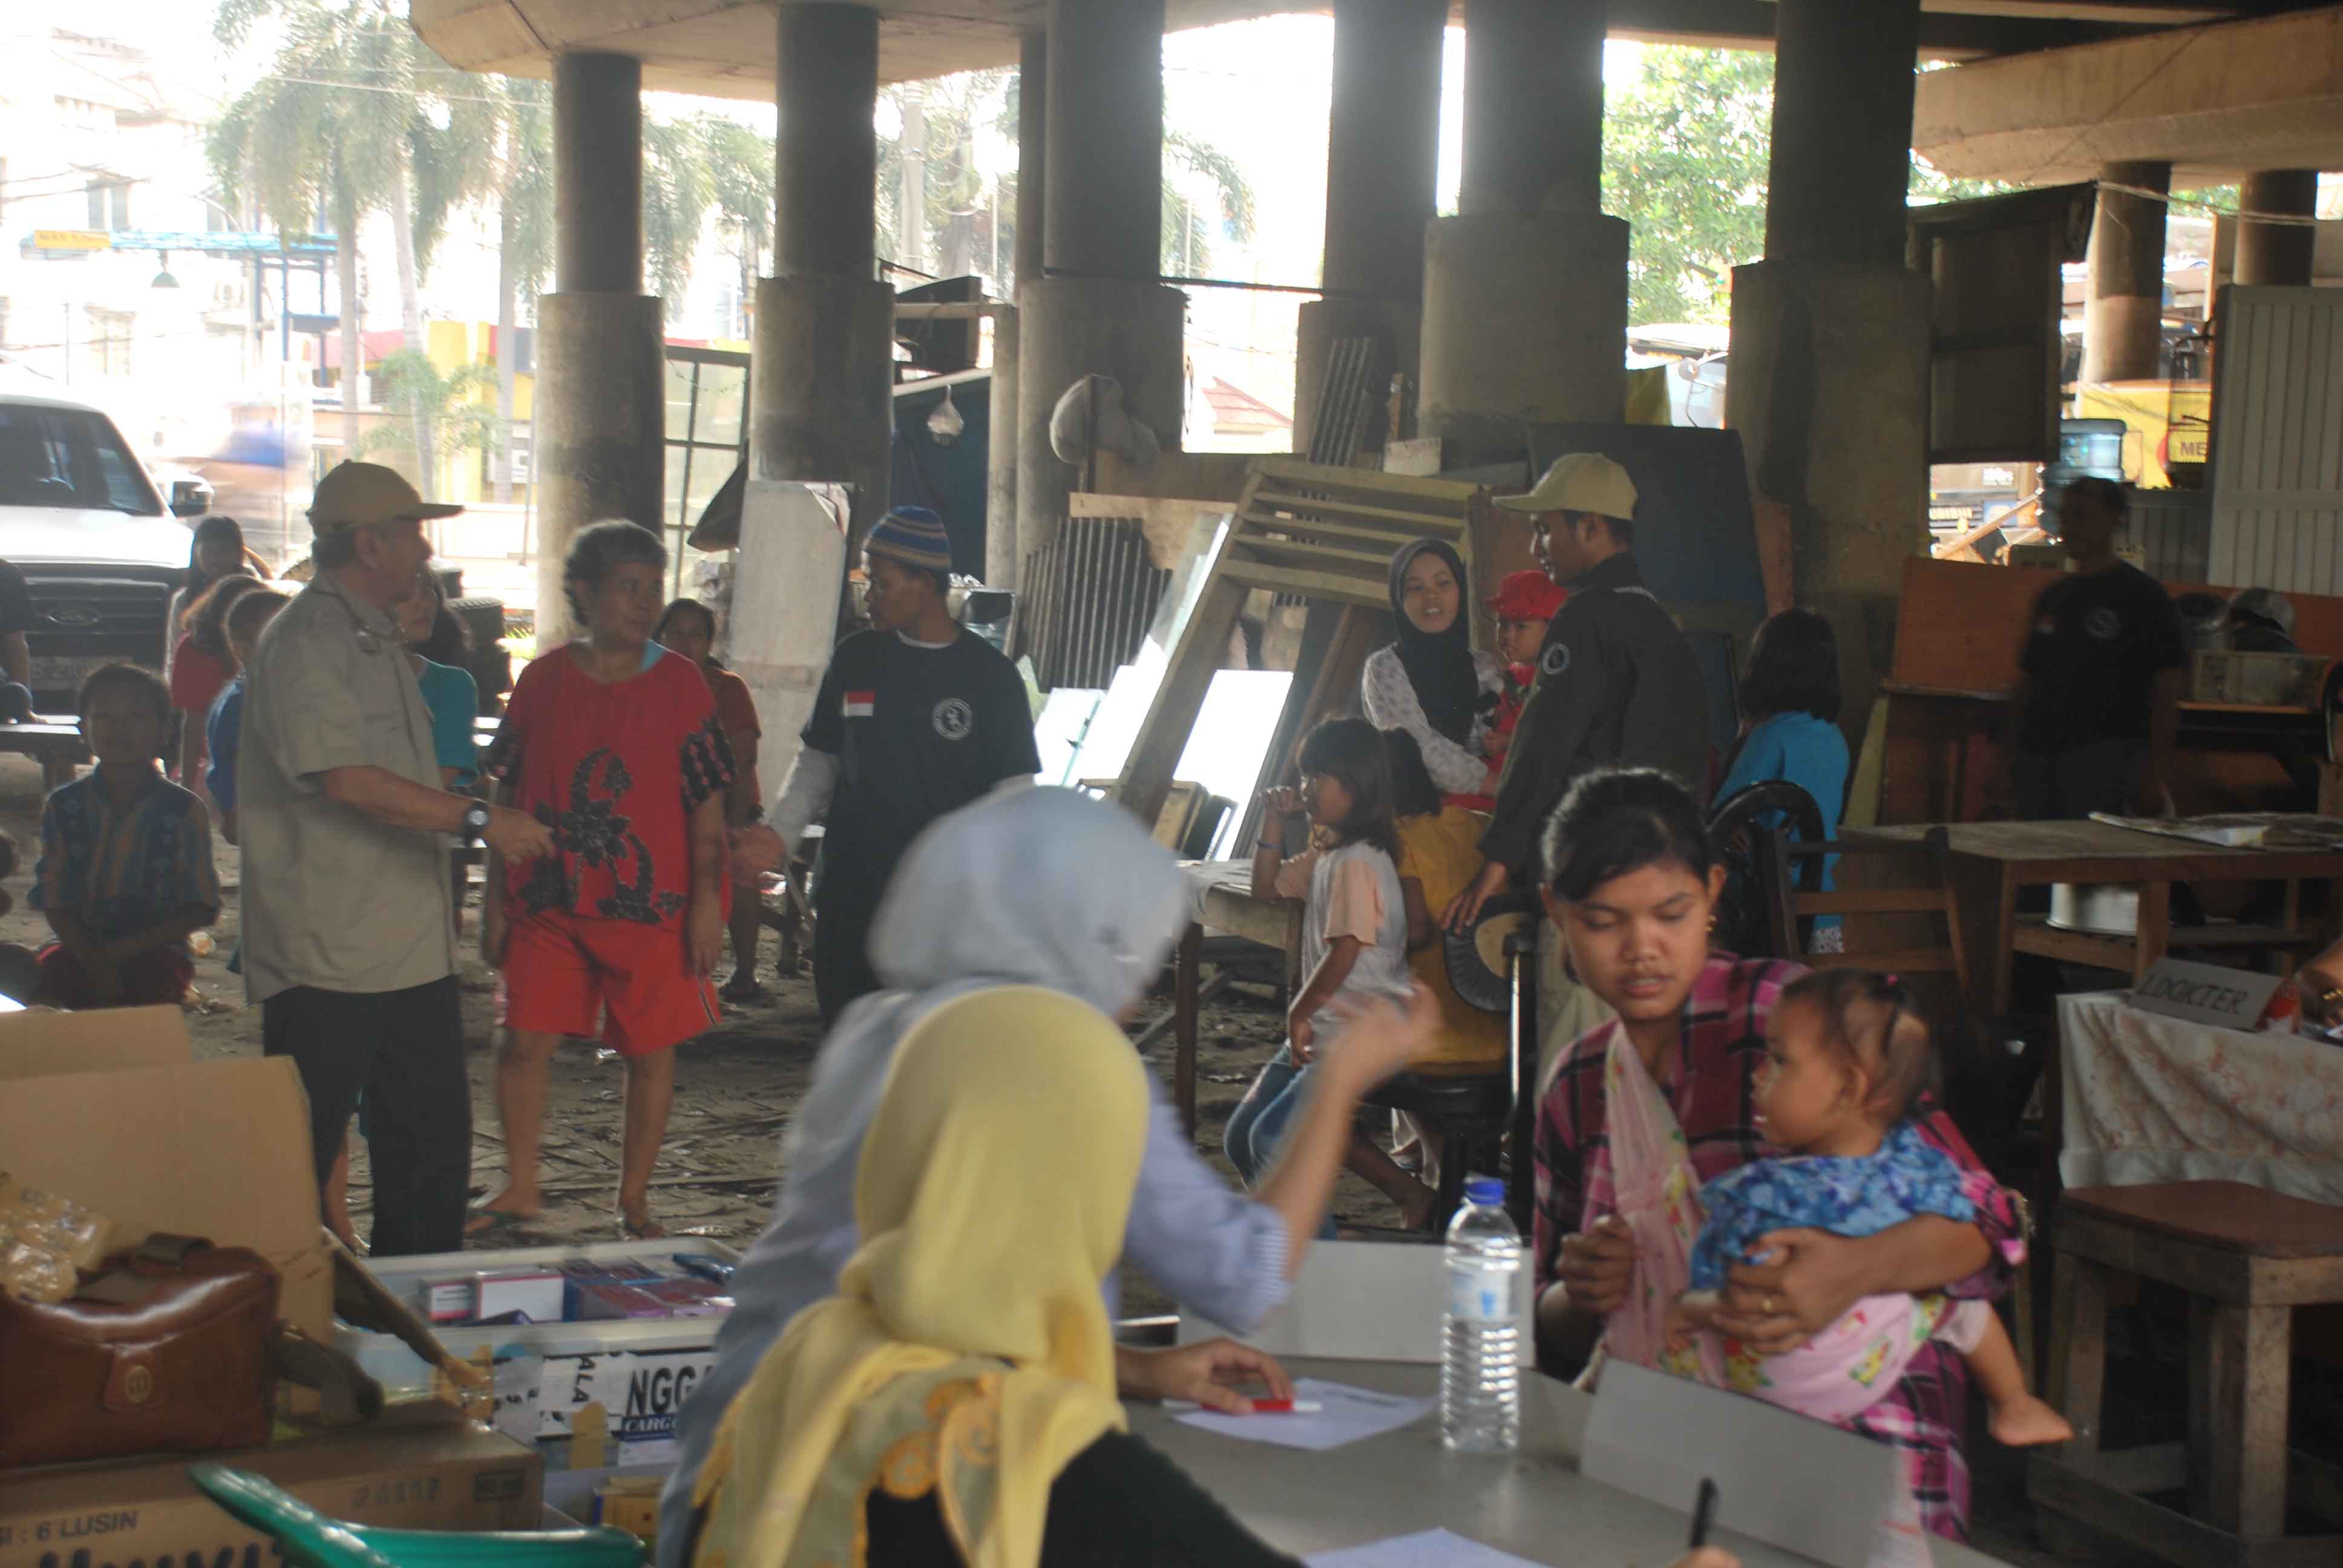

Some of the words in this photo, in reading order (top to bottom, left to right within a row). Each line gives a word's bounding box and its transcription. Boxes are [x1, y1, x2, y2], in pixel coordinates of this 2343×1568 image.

[626, 1365, 715, 1416] NGG
[624, 1417, 678, 1432] CARG
[36, 1520, 51, 1542] 6
[60, 1510, 138, 1539] LUSIN
